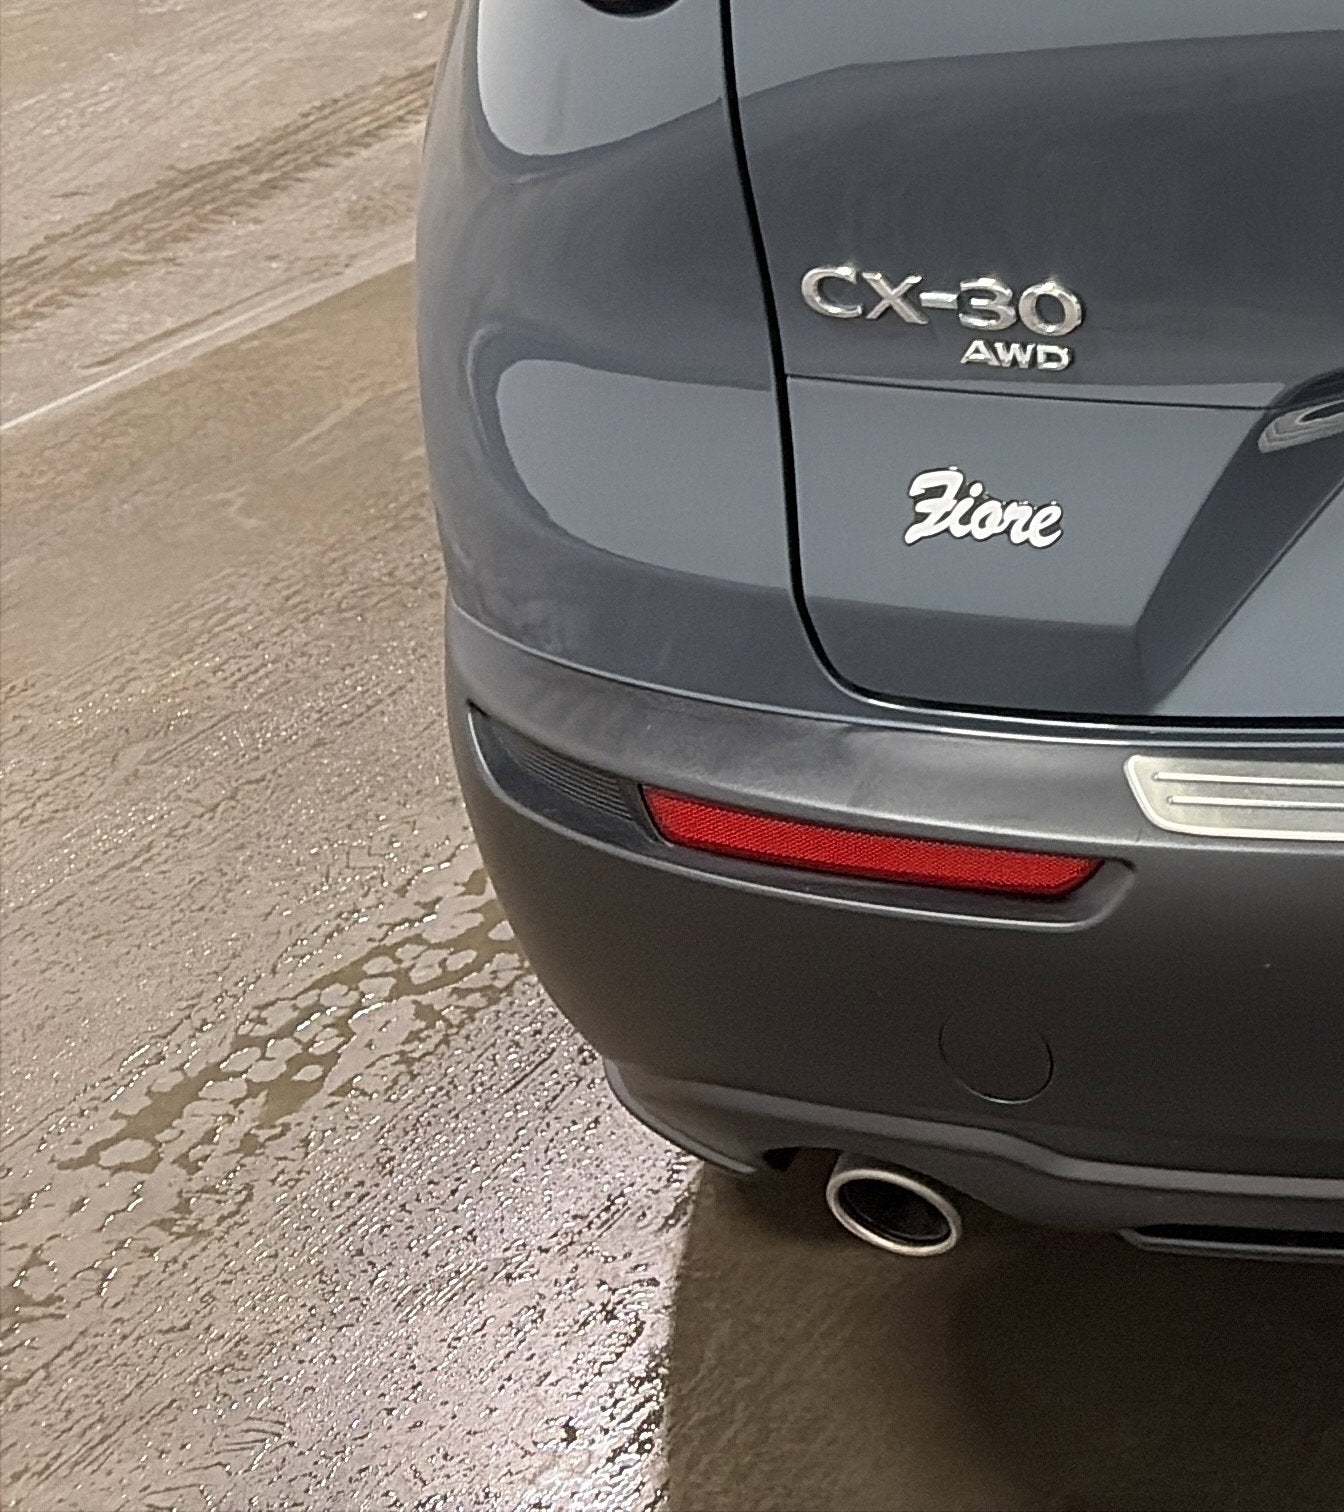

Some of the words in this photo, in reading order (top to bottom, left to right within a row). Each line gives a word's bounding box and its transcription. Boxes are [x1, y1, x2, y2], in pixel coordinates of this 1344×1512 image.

[801, 263, 1083, 337] CX-30
[960, 340, 1072, 371] AWD
[904, 467, 1064, 548] Fiore
